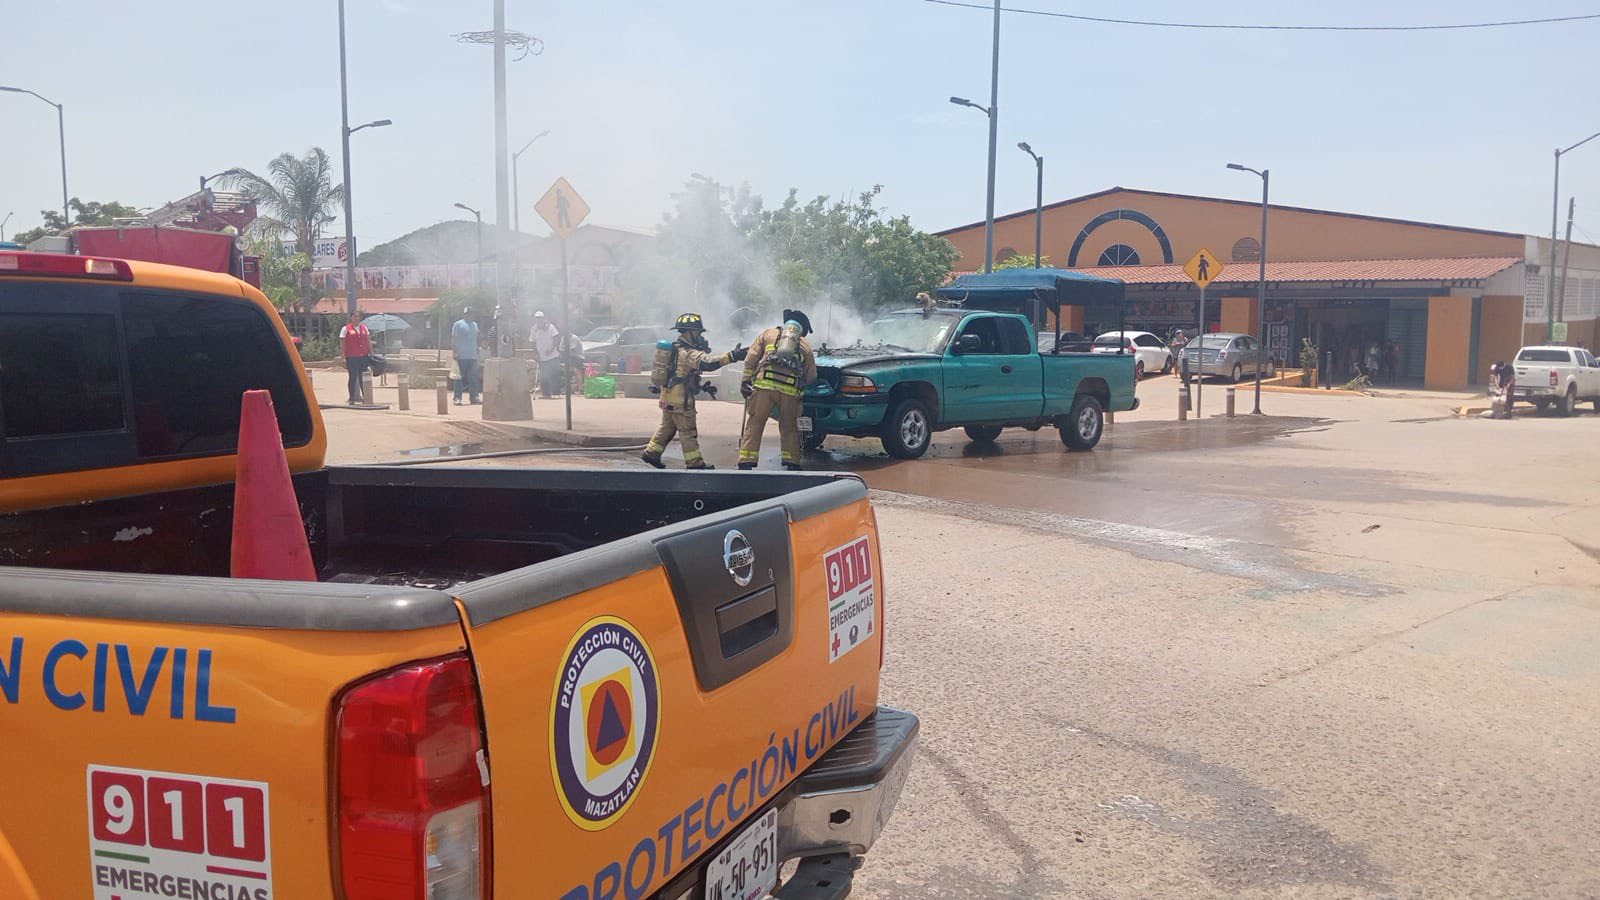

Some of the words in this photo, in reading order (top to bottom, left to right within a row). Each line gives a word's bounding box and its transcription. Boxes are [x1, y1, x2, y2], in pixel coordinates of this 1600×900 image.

[830, 546, 868, 594] 911
[830, 593, 874, 631] EMERGENCIAS
[42, 639, 236, 724] CIVIL
[560, 628, 620, 709] PROTECCIÓN
[623, 636, 646, 674] CIVIL
[103, 784, 245, 849] 911
[558, 728, 799, 900] ROTECCIÓN
[804, 685, 858, 760] CIVIL
[584, 767, 640, 816] MAZATLÁN
[95, 865, 268, 900] EMERGENCIAS
